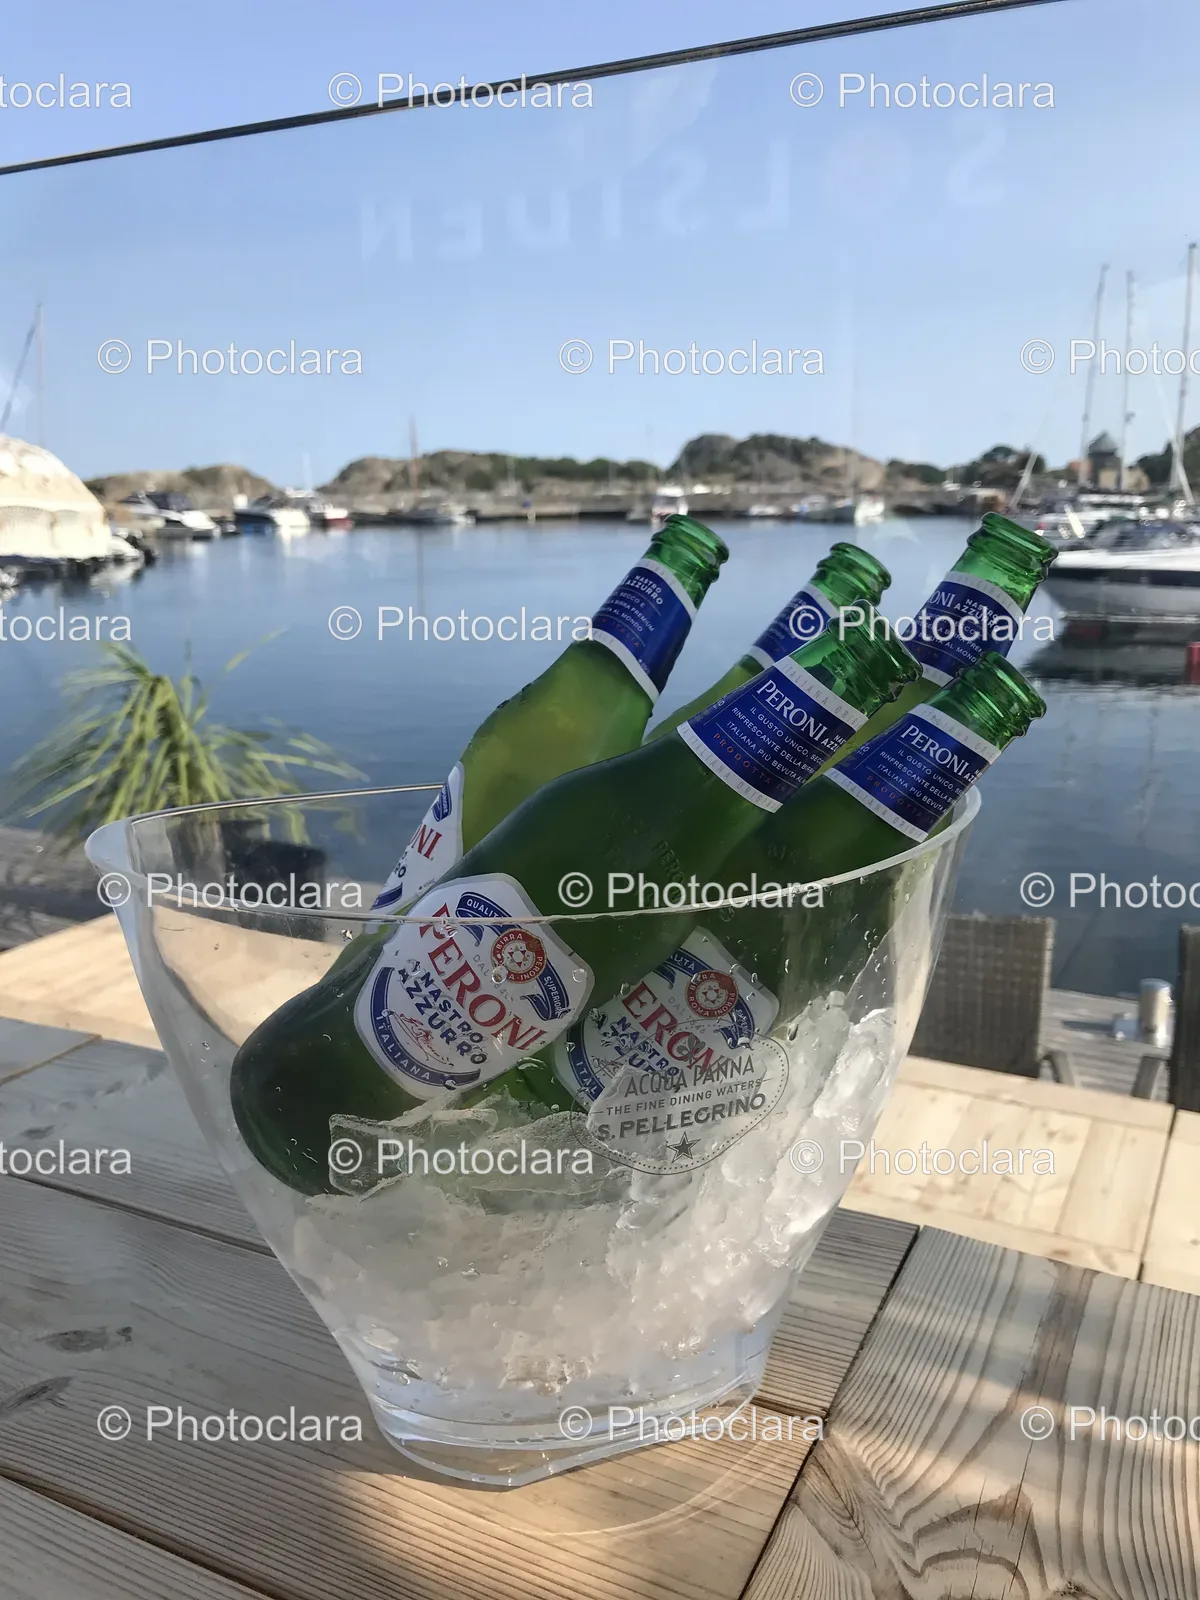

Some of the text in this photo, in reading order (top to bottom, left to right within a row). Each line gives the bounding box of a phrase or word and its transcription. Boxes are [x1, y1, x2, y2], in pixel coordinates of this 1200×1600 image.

[626, 580, 664, 606] AZZURRO
[635, 575, 663, 594] NASTRO
[928, 591, 956, 608] ONI
[621, 613, 644, 633] MONDO
[631, 606, 656, 633] PREMIUM
[955, 645, 977, 664] MOND
[748, 705, 758, 715] IL
[755, 712, 785, 738] GUSTO
[756, 679, 828, 742] PERONI
[726, 720, 758, 750] ITALIANA
[755, 746, 772, 762] PIÙ
[770, 756, 798, 781] BEVUTA
[730, 705, 781, 753] RINFRESCANTE
[779, 748, 802, 768] DELLA
[900, 724, 970, 776] PERONI
[711, 731, 772, 784] PRODOTTA
[878, 750, 948, 801] RINFRESCANTE DELLA
[897, 749, 905, 757] IL
[904, 754, 933, 776] GUSTO
[876, 763, 943, 812] ITALIANA PIÙ BEVUTA
[466, 899, 501, 919] QUALIT
[497, 933, 524, 952] BIRRA
[521, 955, 543, 981] PERONI
[397, 966, 488, 1065] AZZURRO
[420, 970, 484, 1044] NASTRO
[688, 996, 711, 1017] ROMA
[714, 992, 736, 1016] PERONI
[621, 980, 716, 1072] ERON
[375, 1014, 431, 1081] ITALIANA
[575, 1060, 600, 1096] ITAL
[624, 1054, 755, 1098] ACQUA PANNA
[606, 1077, 763, 1116] THE FINE DINING WATERS
